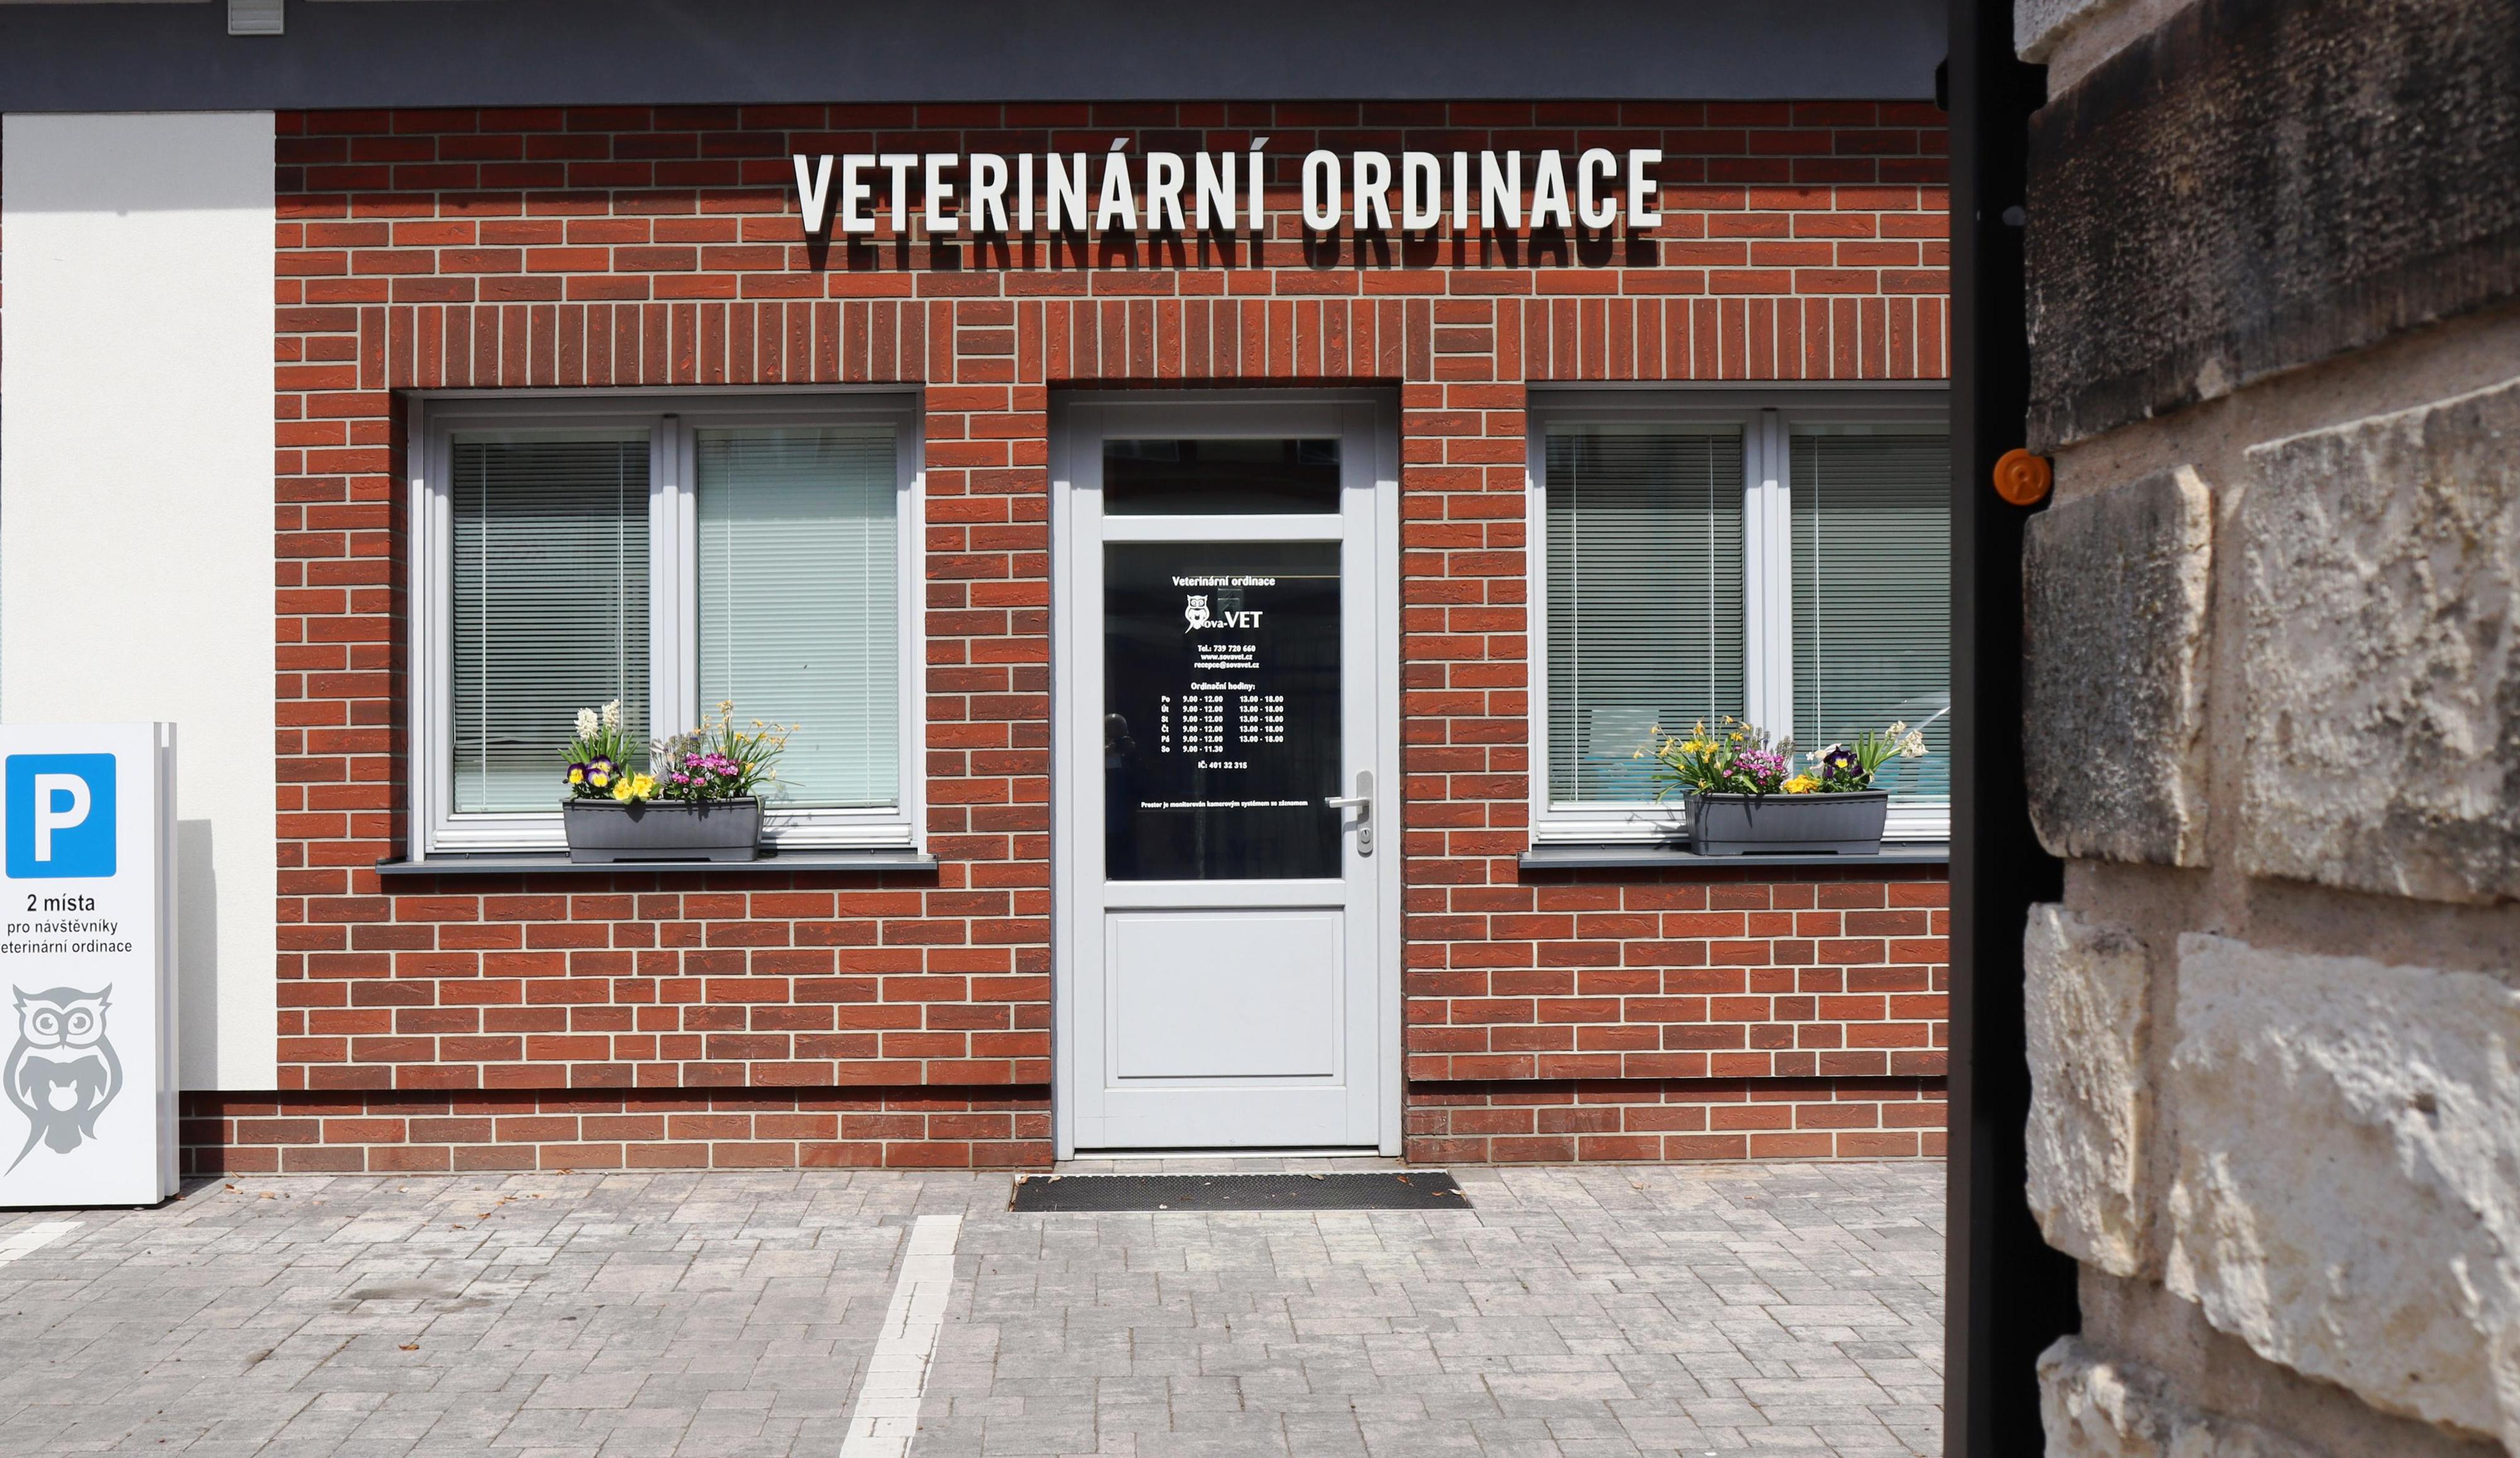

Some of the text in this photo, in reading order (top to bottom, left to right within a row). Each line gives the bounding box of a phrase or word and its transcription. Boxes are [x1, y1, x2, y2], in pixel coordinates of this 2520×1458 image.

[793, 137, 1663, 232] VETERINÁRNÍ ORDINACE
[1172, 575, 1276, 586] Veterinární ordinace
[1194, 661, 1260, 669] recepce@sovavet.cz
[1191, 681, 1255, 692] Ordinační hodiny:
[1161, 704, 1169, 713] Út
[1161, 724, 1169, 733] Čt
[1198, 760, 1207, 769] IČ:
[1163, 801, 1169, 809] je
[1206, 800, 1240, 809] kamerovým
[1241, 800, 1269, 808] systémem
[35, 773, 91, 862] P
[27, 893, 94, 911] 2 místa
[8, 920, 118, 936] pro návštěvníky
[1, 940, 132, 953] eterinární ordinace
